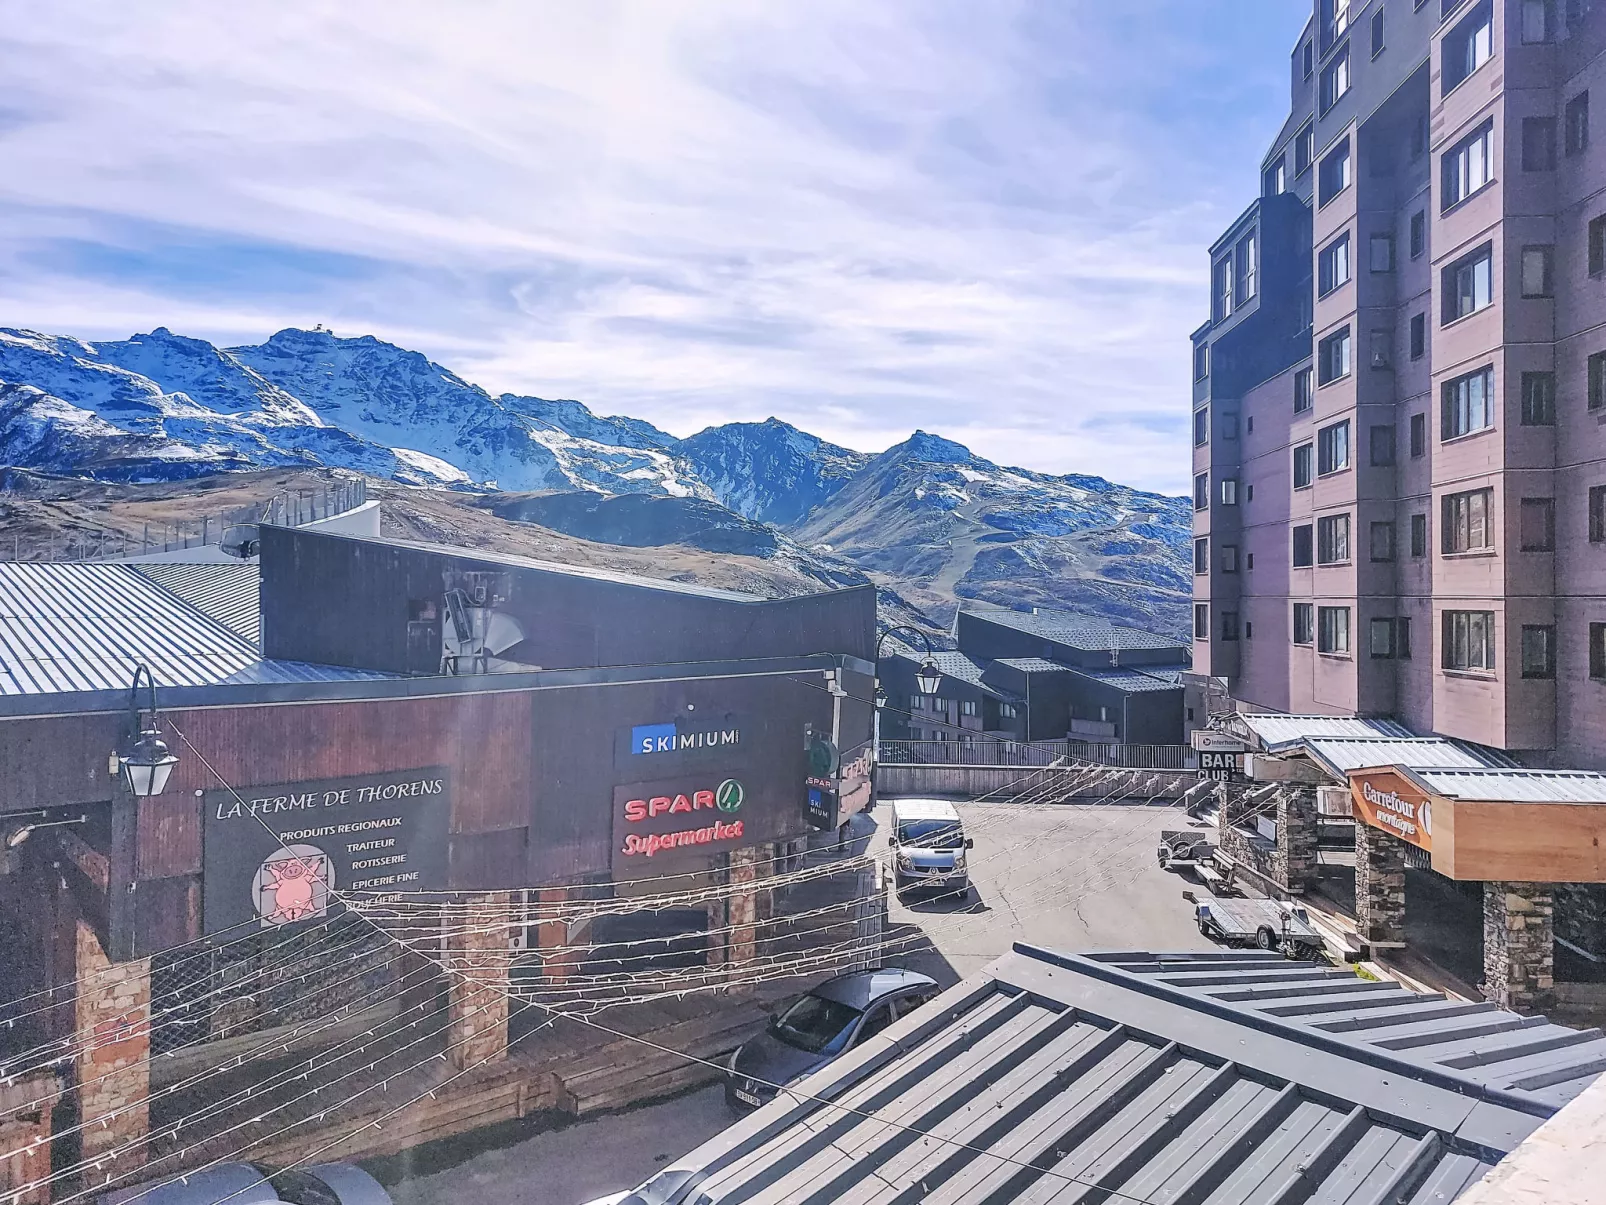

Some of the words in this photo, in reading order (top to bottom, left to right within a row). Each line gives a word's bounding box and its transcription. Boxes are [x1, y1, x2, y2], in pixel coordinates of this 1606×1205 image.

[642, 730, 735, 753] SKIMIUM
[1202, 753, 1235, 768] BAR
[807, 776, 831, 788] SPAR
[1197, 770, 1229, 781] CLUB
[215, 802, 243, 820] LA
[250, 792, 318, 817] FERME
[323, 789, 351, 808] DE
[357, 779, 444, 804] THORENS
[624, 790, 716, 821] SPAR
[810, 799, 821, 808] SKI
[1363, 781, 1415, 819] Carrefour
[810, 806, 828, 818] MIUM
[280, 825, 336, 842] PRODUITS
[338, 816, 403, 834] REGIONAUX
[1376, 809, 1416, 837] montagne
[346, 838, 396, 853] TRAITEUR
[622, 820, 744, 857] Supermarket
[352, 854, 407, 870] ROTISSERIE
[352, 874, 396, 891] EPICERIE
[397, 871, 420, 885] FINE
